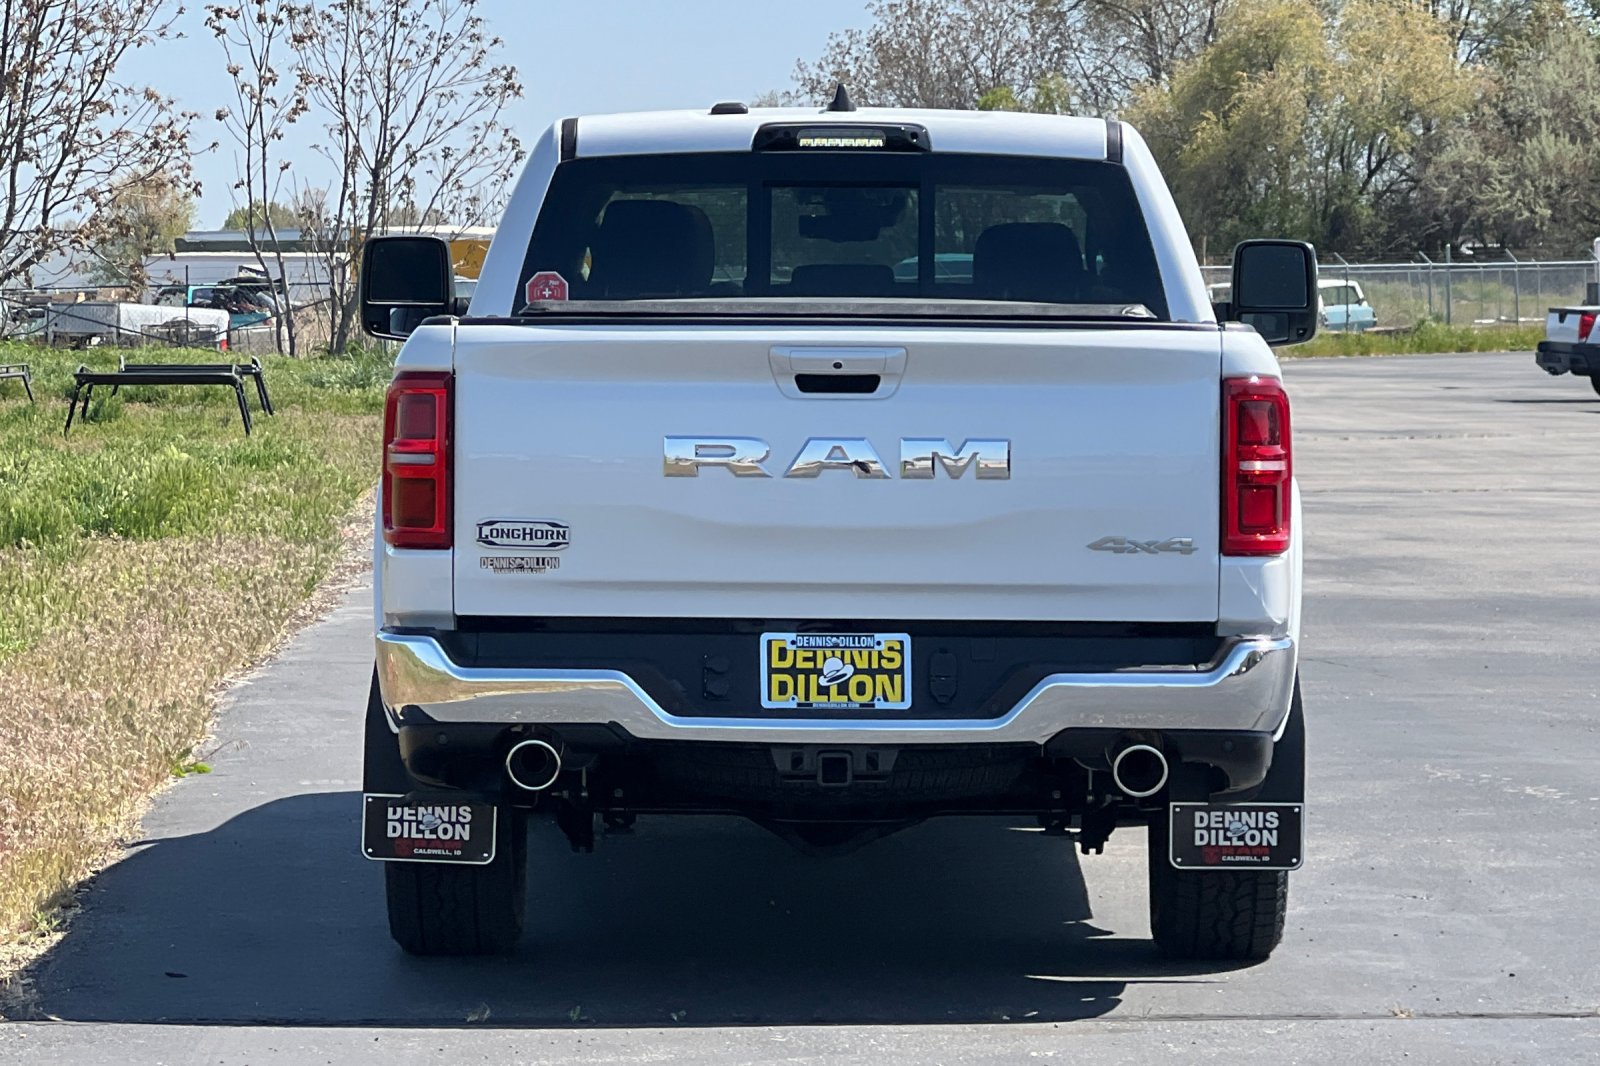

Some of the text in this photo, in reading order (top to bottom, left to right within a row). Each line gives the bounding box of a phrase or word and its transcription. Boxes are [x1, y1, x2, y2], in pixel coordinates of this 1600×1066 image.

[663, 435, 1011, 480] RAM
[481, 557, 559, 569] DENNIS DILLON
[797, 636, 874, 648] DENNIS DILLON
[771, 674, 902, 703] DILLON
[387, 806, 472, 823] DENNIS
[1194, 811, 1279, 828] DENNIS
[387, 821, 470, 841] DILLON
[1194, 829, 1278, 846] DILLON
